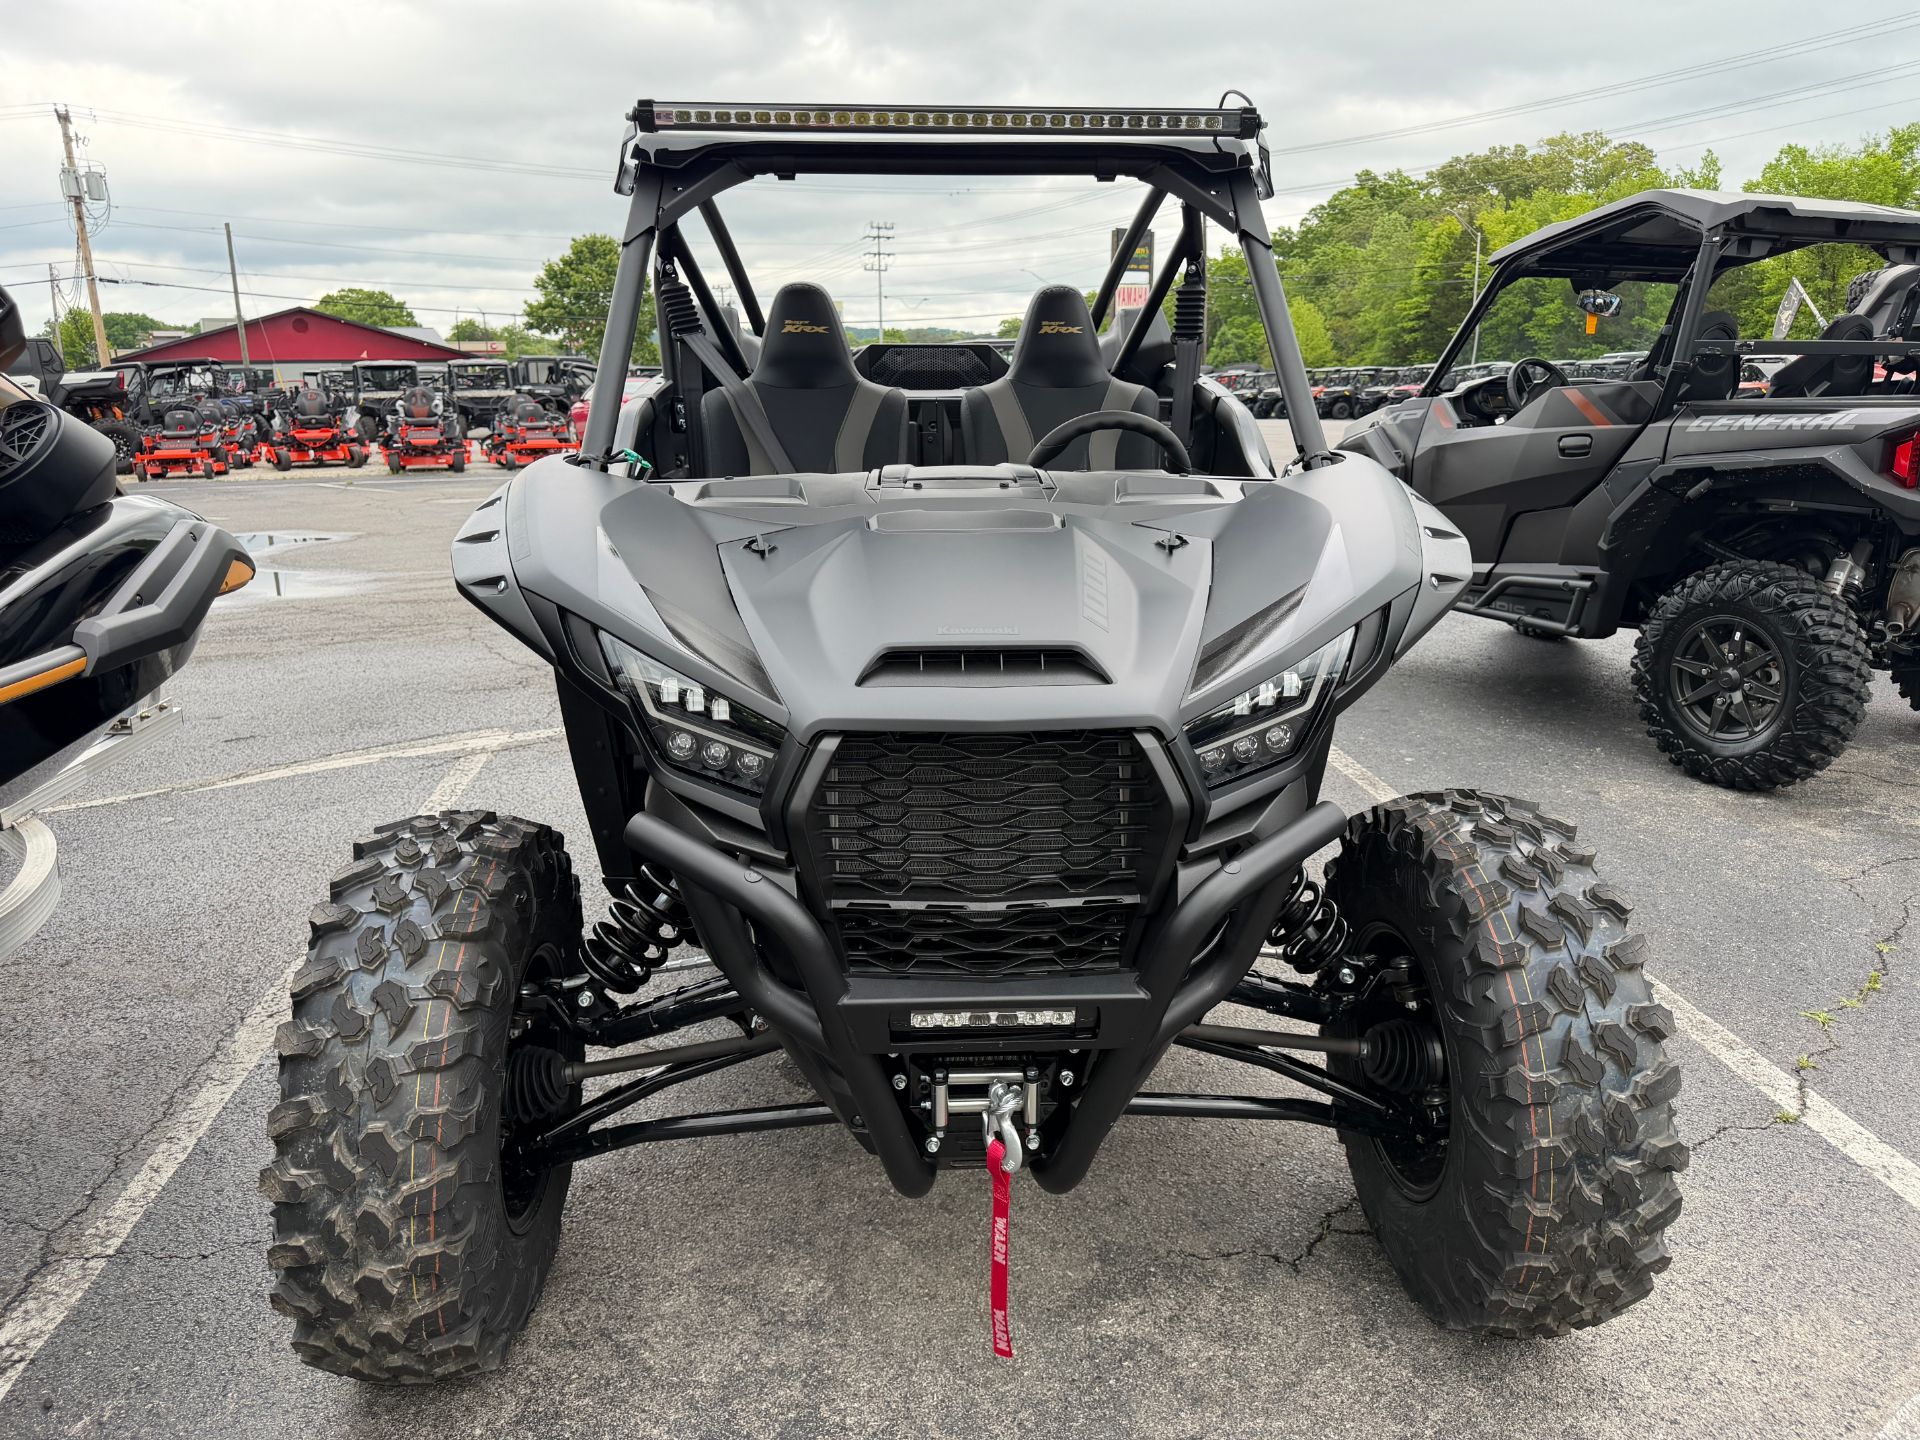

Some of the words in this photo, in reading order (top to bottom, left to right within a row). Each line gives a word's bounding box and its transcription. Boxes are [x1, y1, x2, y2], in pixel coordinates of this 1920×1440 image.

[1117, 287, 1149, 306] YAMAHA
[781, 325, 829, 333] KRX
[1038, 326, 1083, 334] KRX
[1685, 414, 1859, 432] GENERAL
[936, 625, 1020, 635] Kawasaki
[994, 1217, 1007, 1266] WARN
[993, 1309, 1009, 1351] WARN
